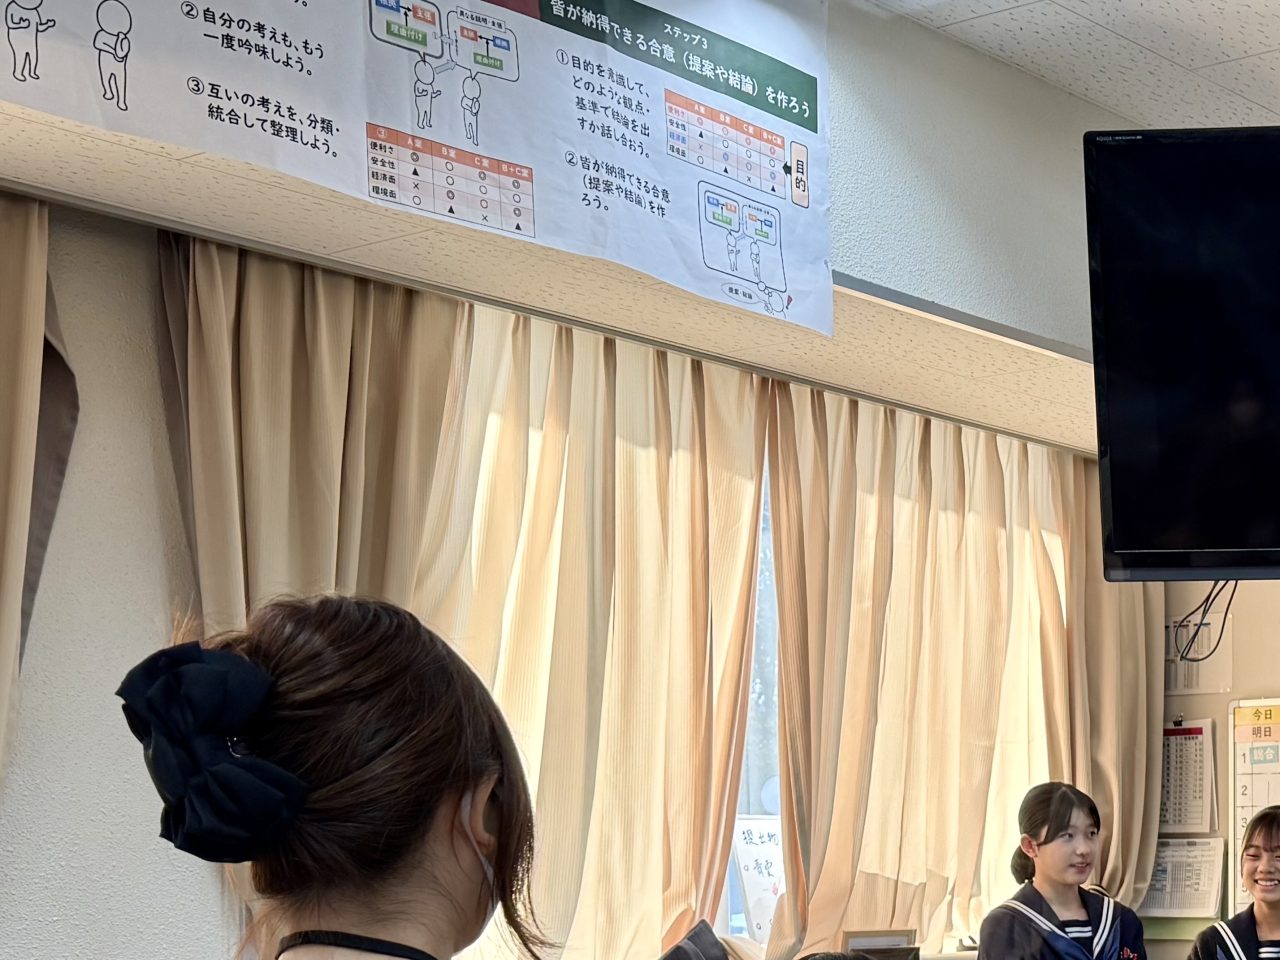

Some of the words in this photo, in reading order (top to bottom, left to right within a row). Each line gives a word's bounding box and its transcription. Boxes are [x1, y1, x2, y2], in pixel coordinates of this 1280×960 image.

[203, 32, 312, 76] 一度吟味しよう。
[575, 96, 650, 138] 基準で結論を出
[207, 103, 337, 158] 統合して整理しよう。
[577, 116, 650, 159] すか話し合おう。
[370, 156, 397, 170] 安全性
[795, 159, 807, 193] 目的
[581, 192, 609, 211] ろう。
[1252, 708, 1273, 721] 今日
[1252, 726, 1272, 738] 明日
[1241, 753, 1247, 764] 1
[1241, 785, 1248, 796] 2
